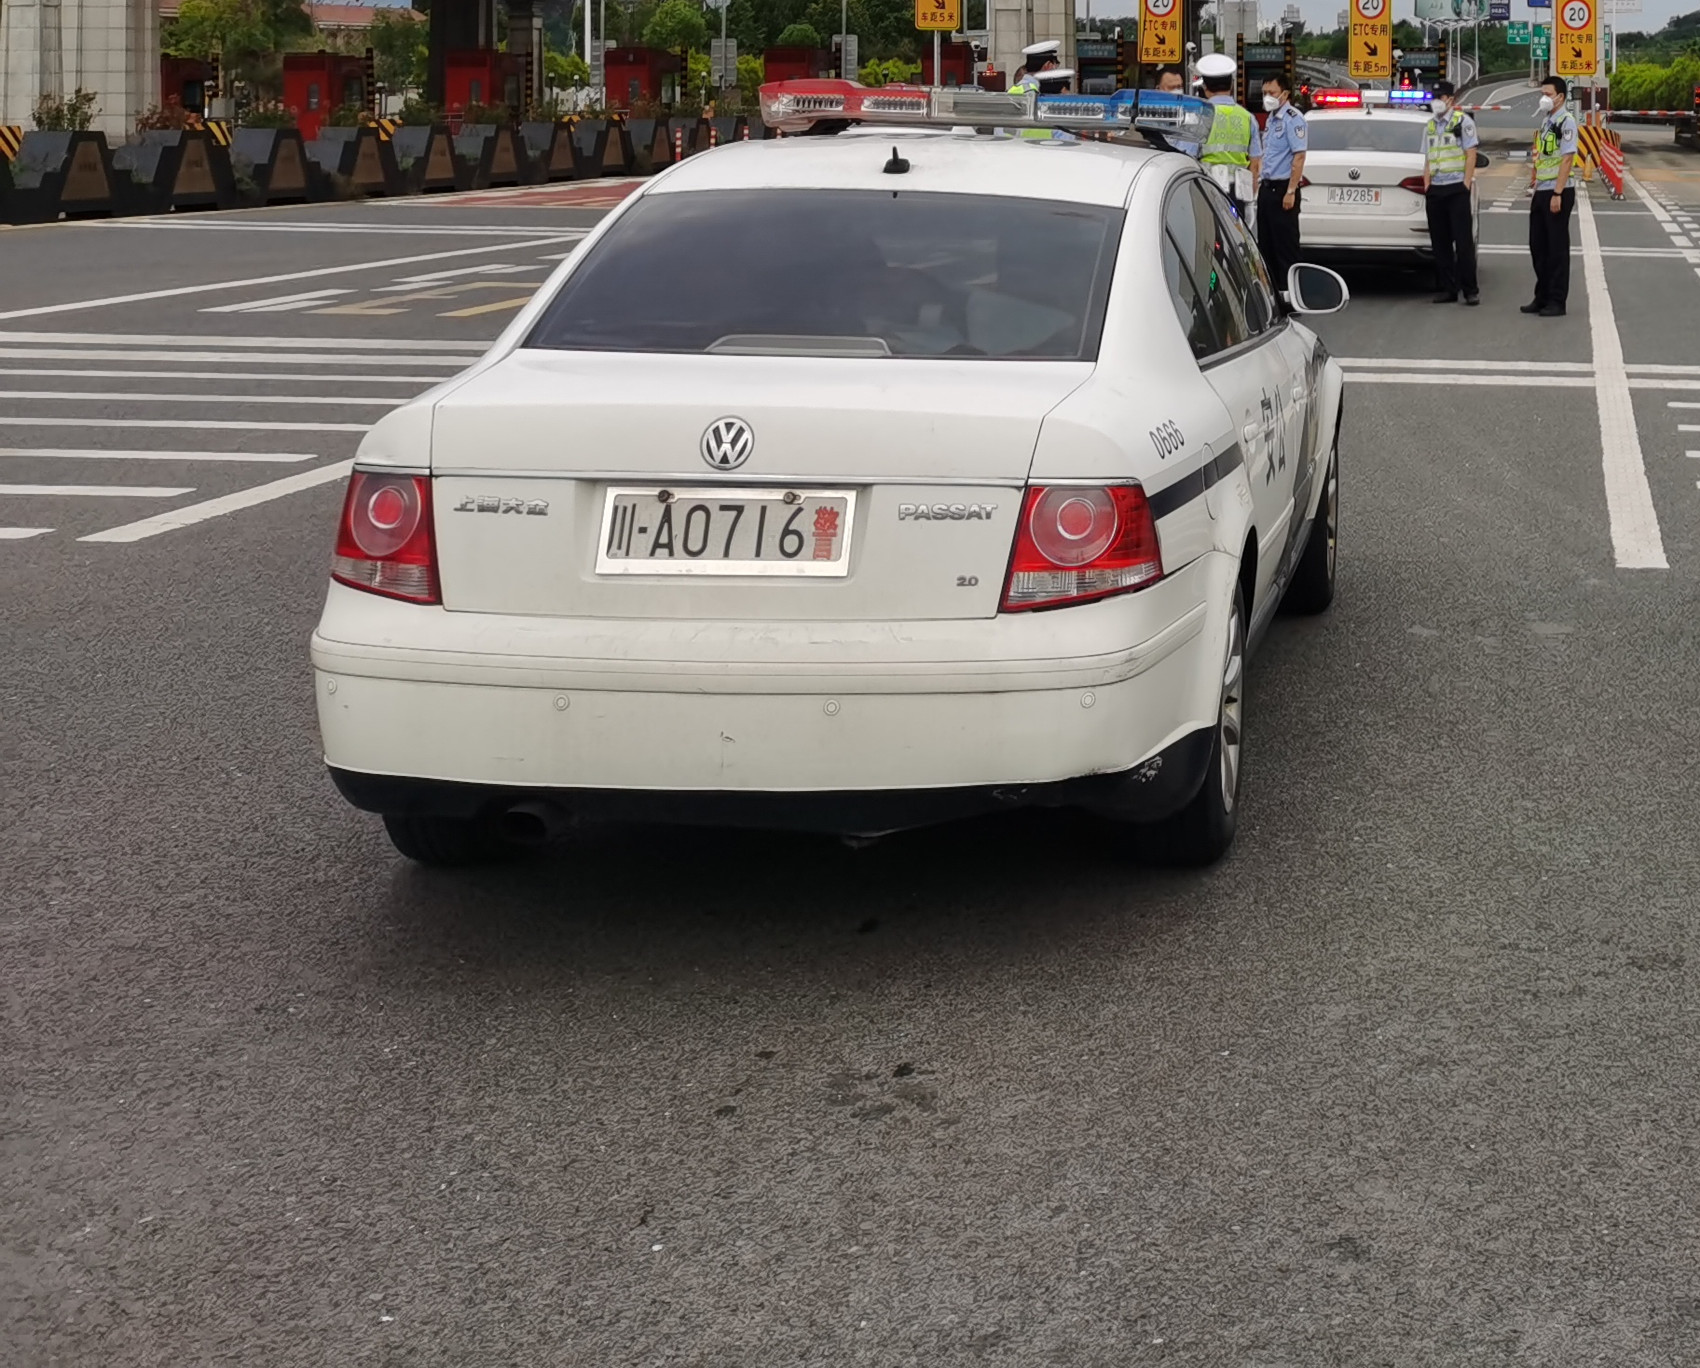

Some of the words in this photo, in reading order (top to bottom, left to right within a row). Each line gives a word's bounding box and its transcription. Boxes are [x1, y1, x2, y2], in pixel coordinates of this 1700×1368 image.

[921, 12, 956, 22] 车距5米
[1568, 7, 1586, 22] 20
[1353, 23, 1388, 36] ETC专用
[1560, 33, 1593, 44] ETC专用
[1143, 47, 1177, 58] 车距5米
[1560, 60, 1593, 71] 车距5米
[897, 502, 999, 521] PASSAT
